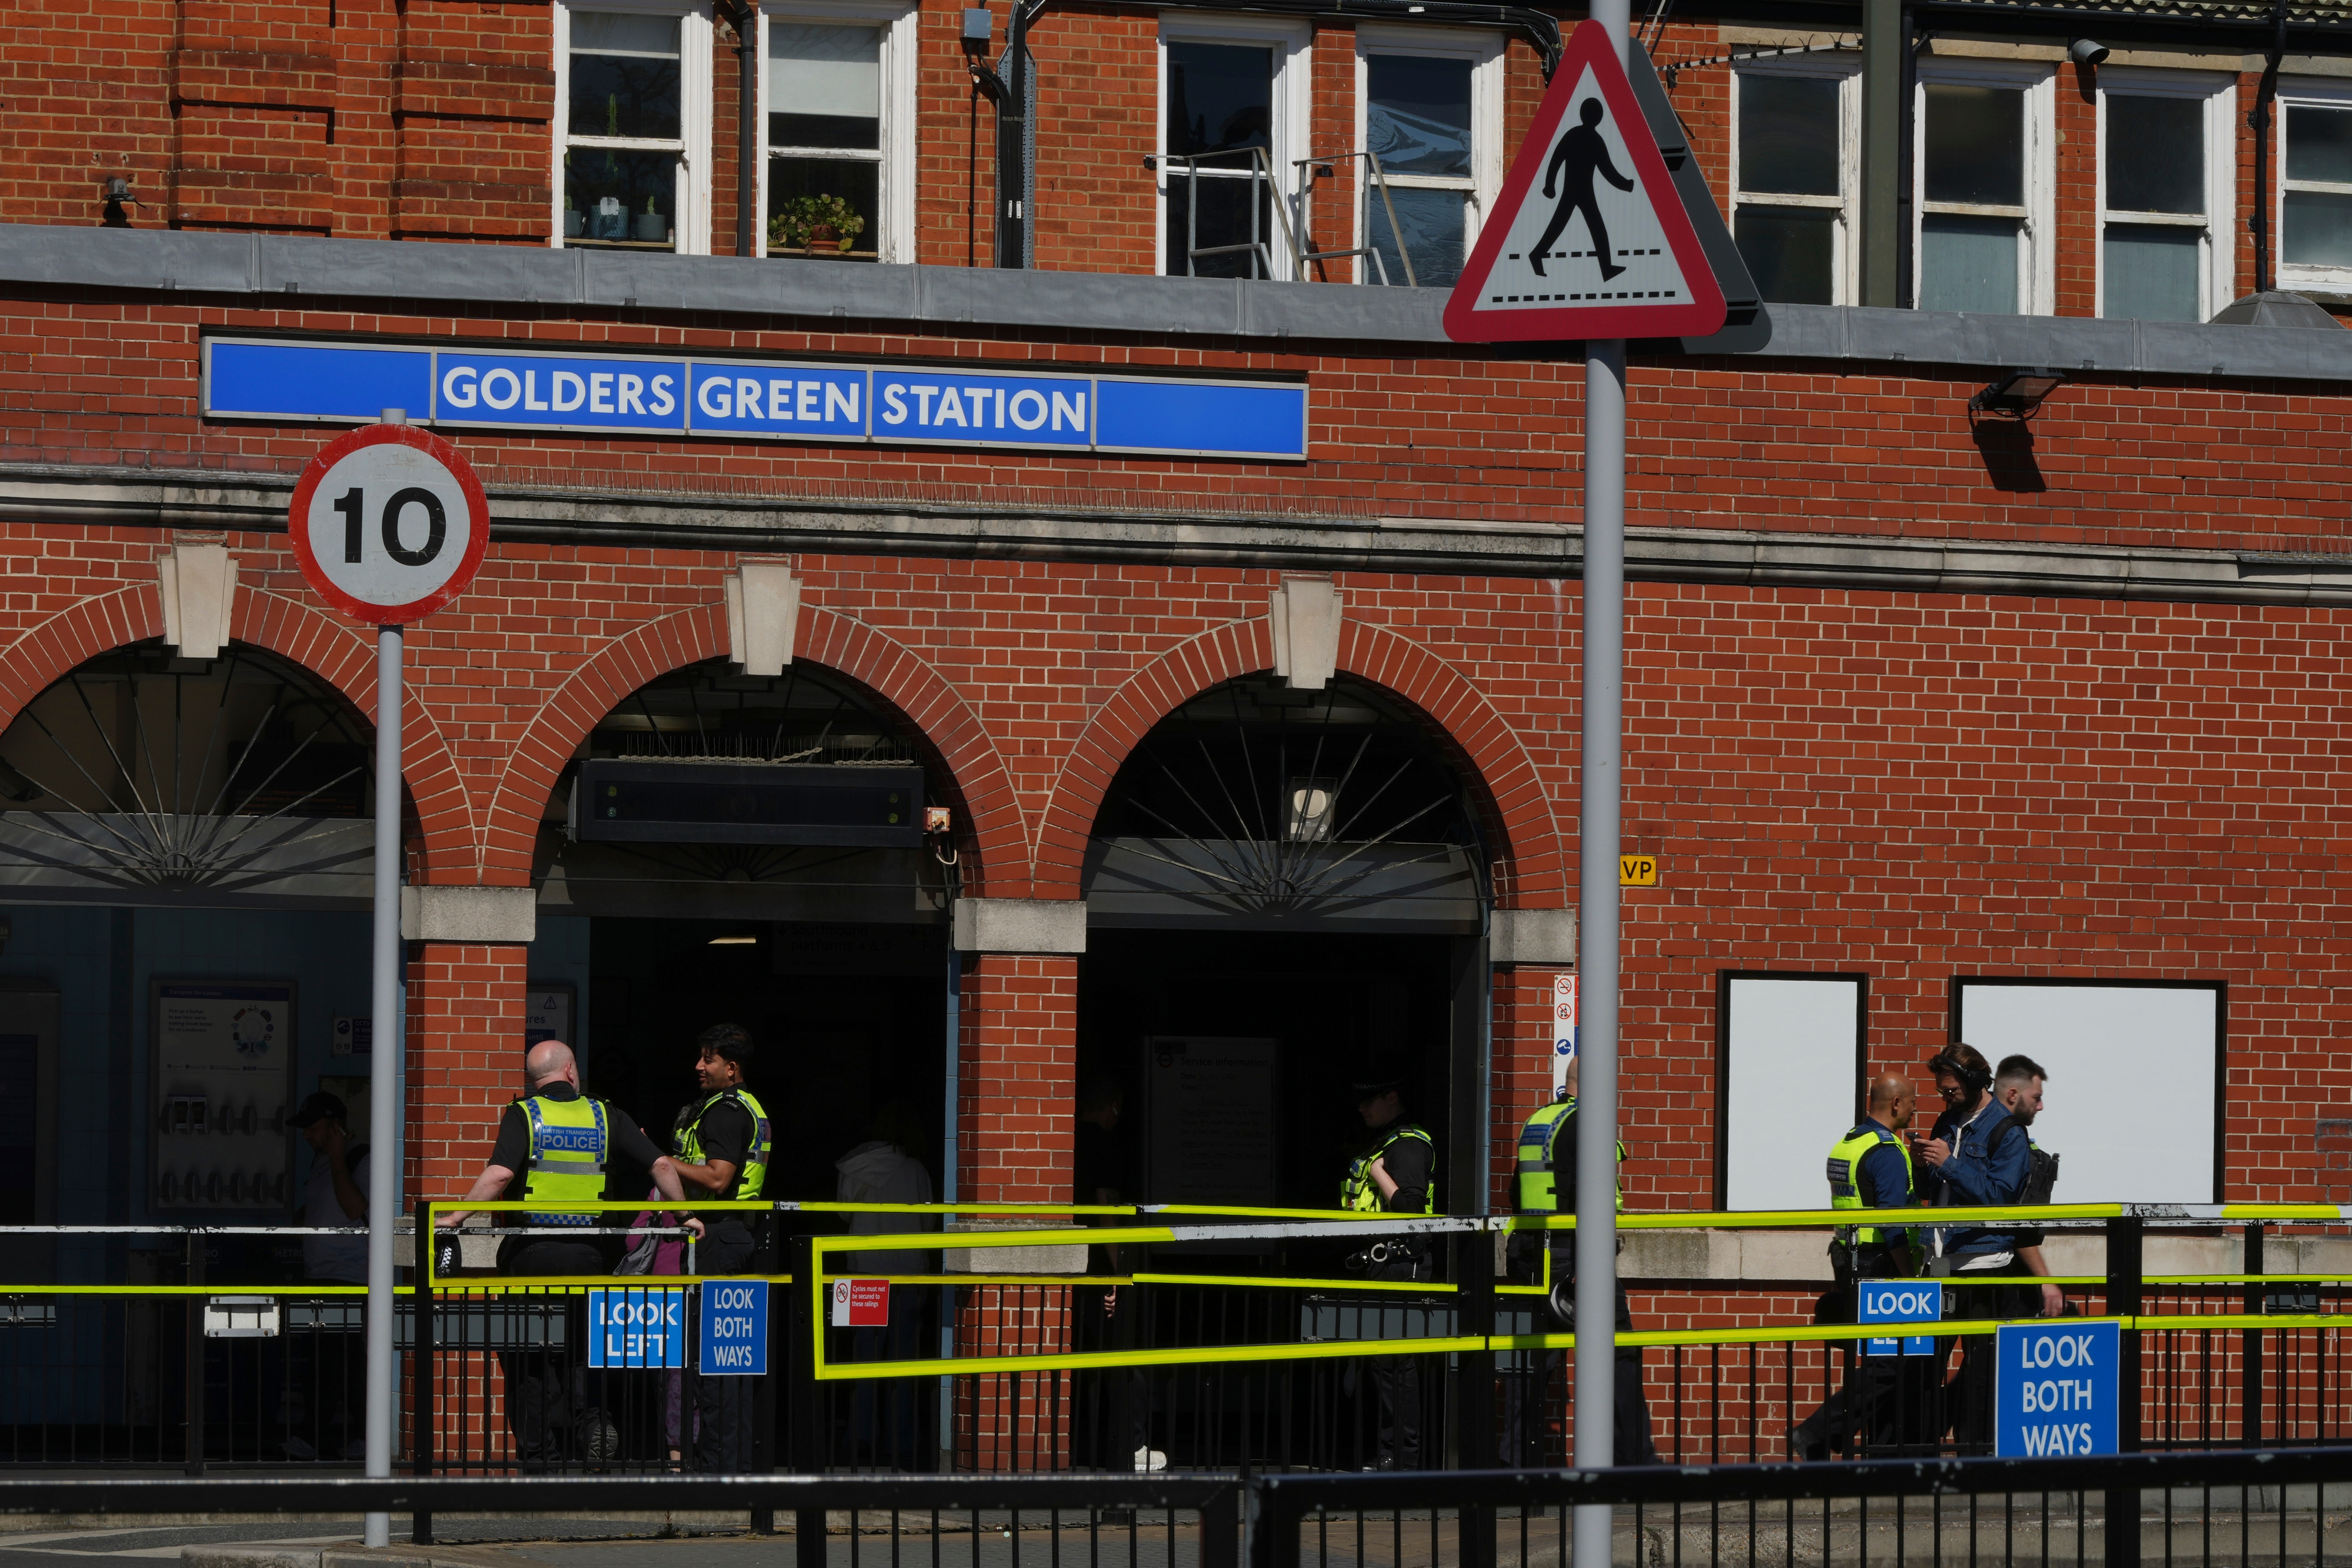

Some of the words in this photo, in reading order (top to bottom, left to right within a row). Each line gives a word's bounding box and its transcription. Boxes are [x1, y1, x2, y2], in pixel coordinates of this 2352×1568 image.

[443, 366, 675, 415] GOLDERS
[698, 376, 859, 422] GREEN
[882, 384, 1085, 431] STATION
[334, 487, 446, 566] 10
[1620, 861, 1652, 879] VP
[1181, 1057, 1213, 1066] Service
[1215, 1058, 1268, 1067] information
[542, 1135, 598, 1149] POLICE
[714, 1288, 754, 1309] LOOK
[1867, 1292, 1933, 1315] LOOK
[600, 1302, 678, 1326] LOOK
[714, 1317, 752, 1337] BOTH
[607, 1334, 669, 1357] LEFT
[714, 1346, 752, 1366] WAYS
[2022, 1335, 2094, 1368] LOOK
[2023, 1379, 2092, 1412] BOTH
[2022, 1423, 2092, 1457] WAYS
